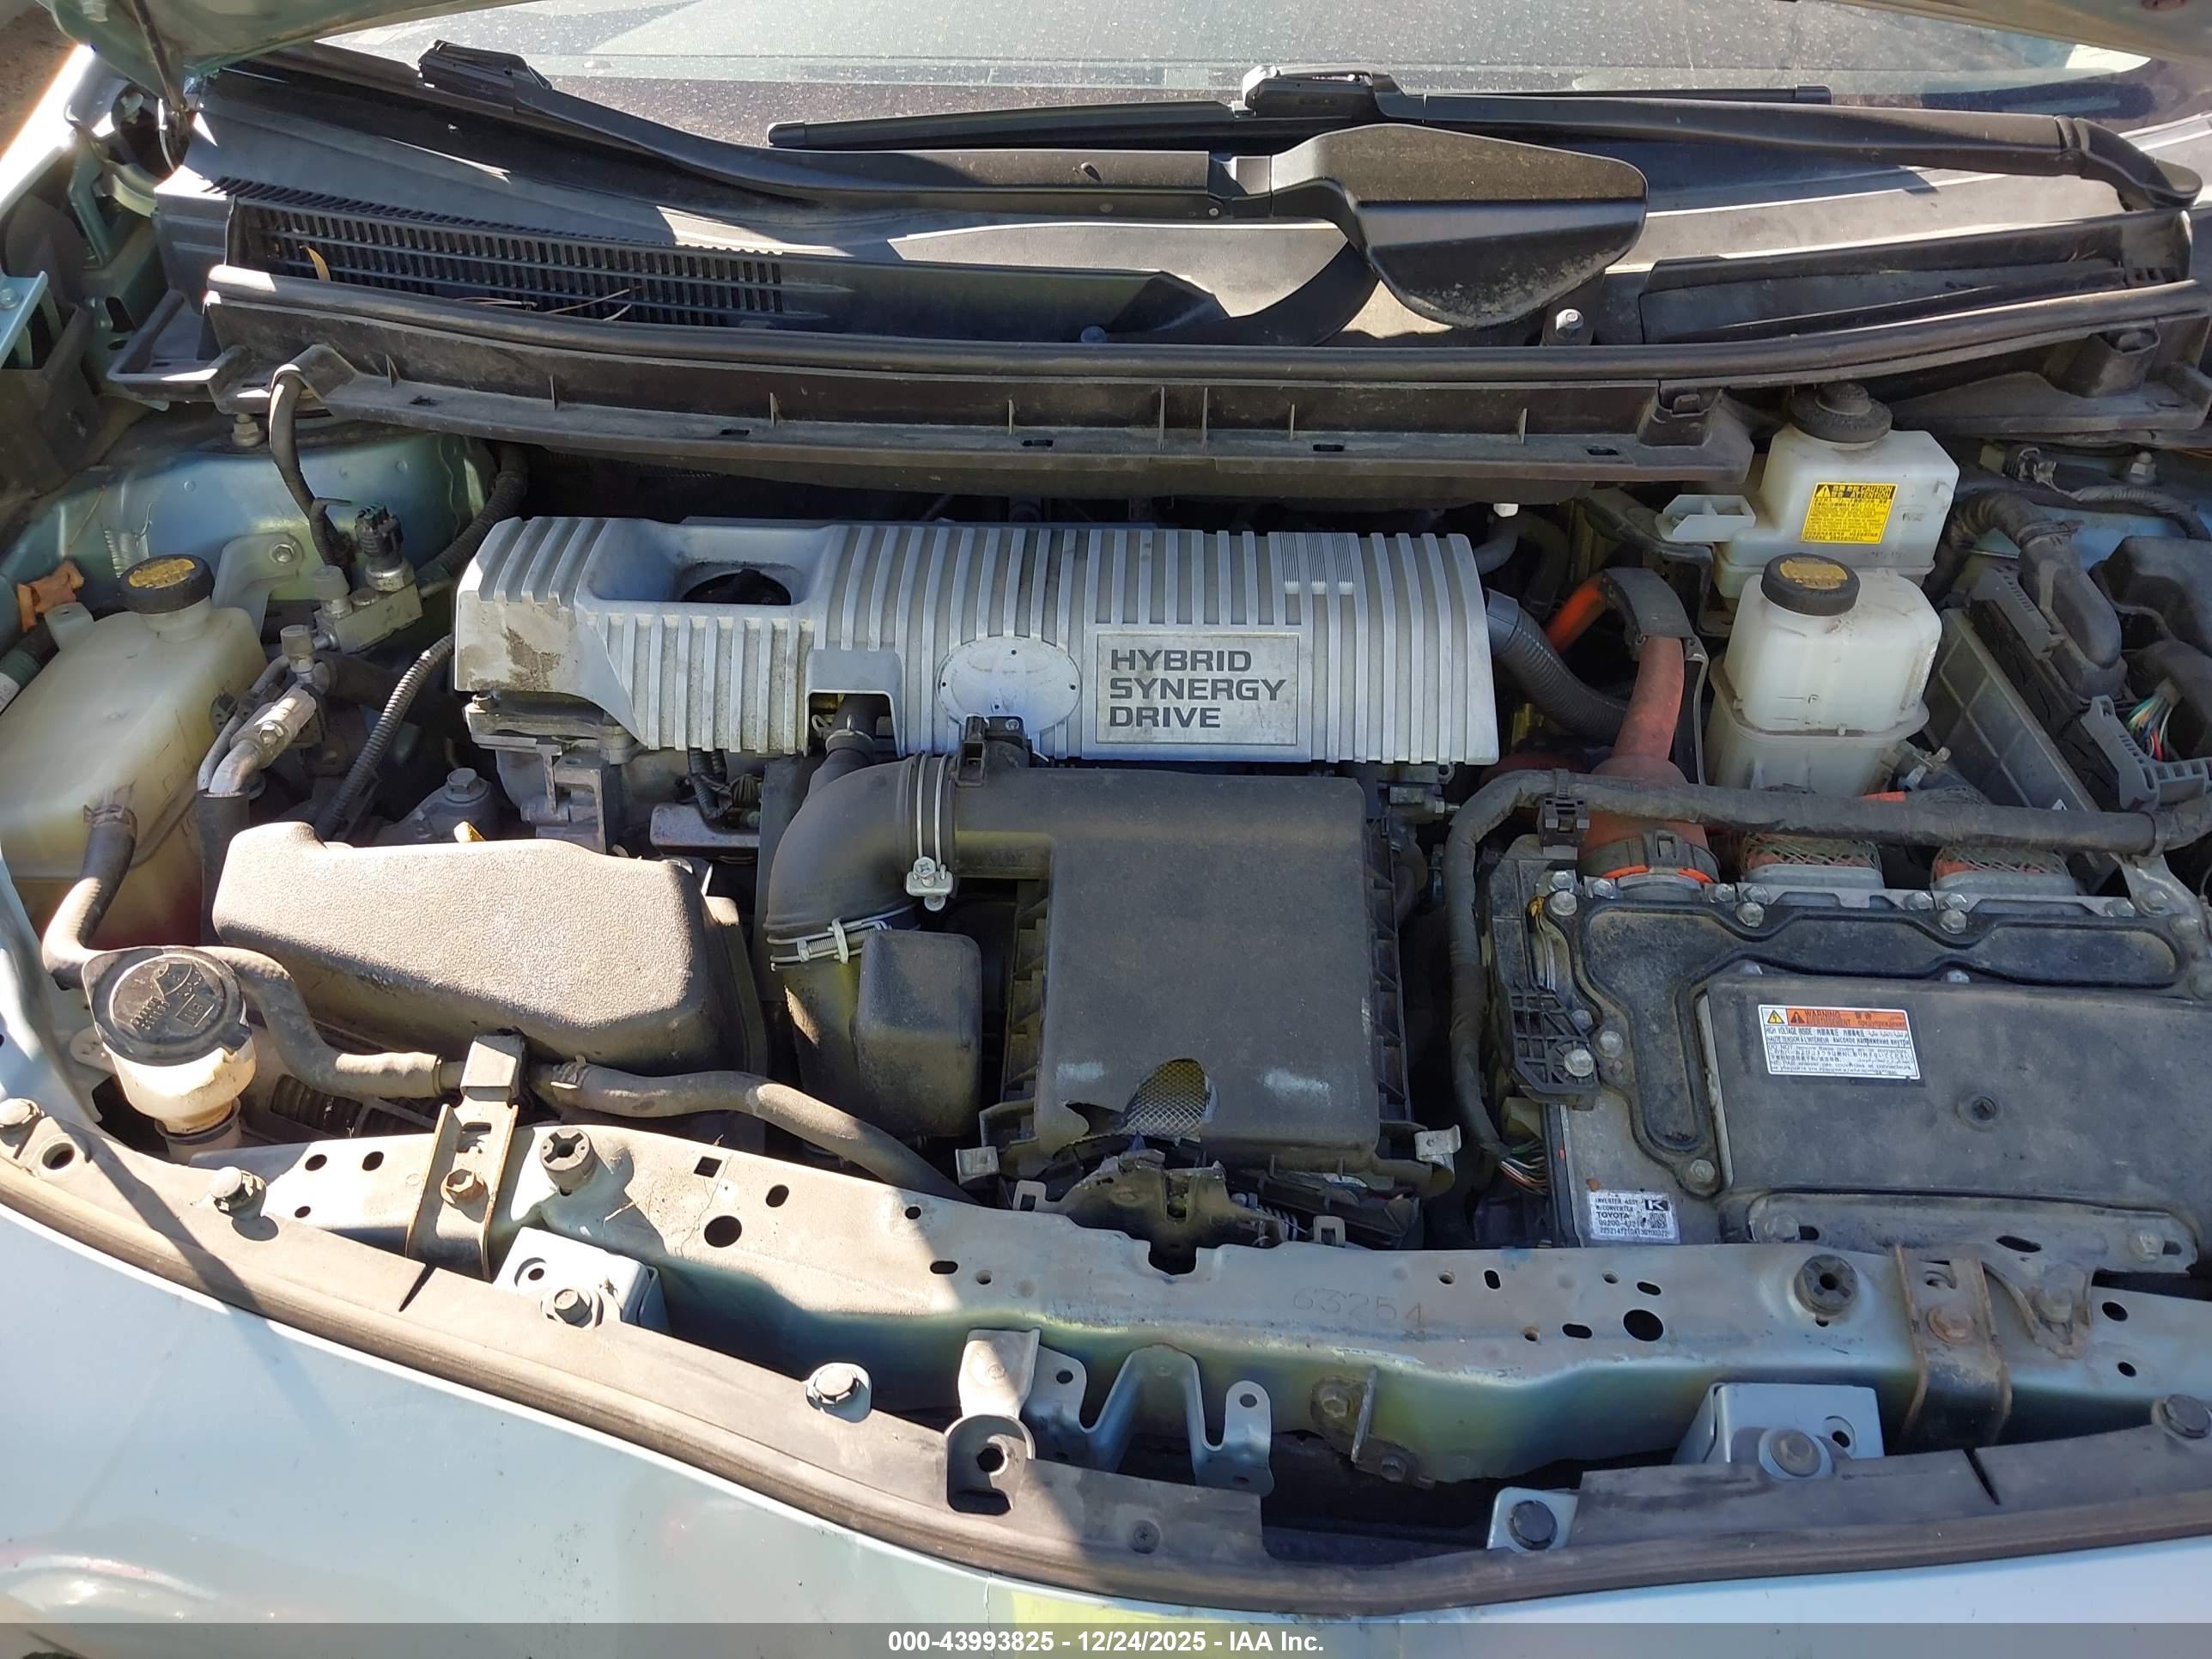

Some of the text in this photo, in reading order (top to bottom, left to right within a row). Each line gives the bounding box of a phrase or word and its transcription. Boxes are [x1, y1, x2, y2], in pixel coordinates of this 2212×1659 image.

[1110, 648, 1252, 672] HYBRID
[1109, 678, 1287, 702] SYNERGY
[1109, 706, 1222, 728] DRIVE
[1293, 1287, 1423, 1328] 63254
